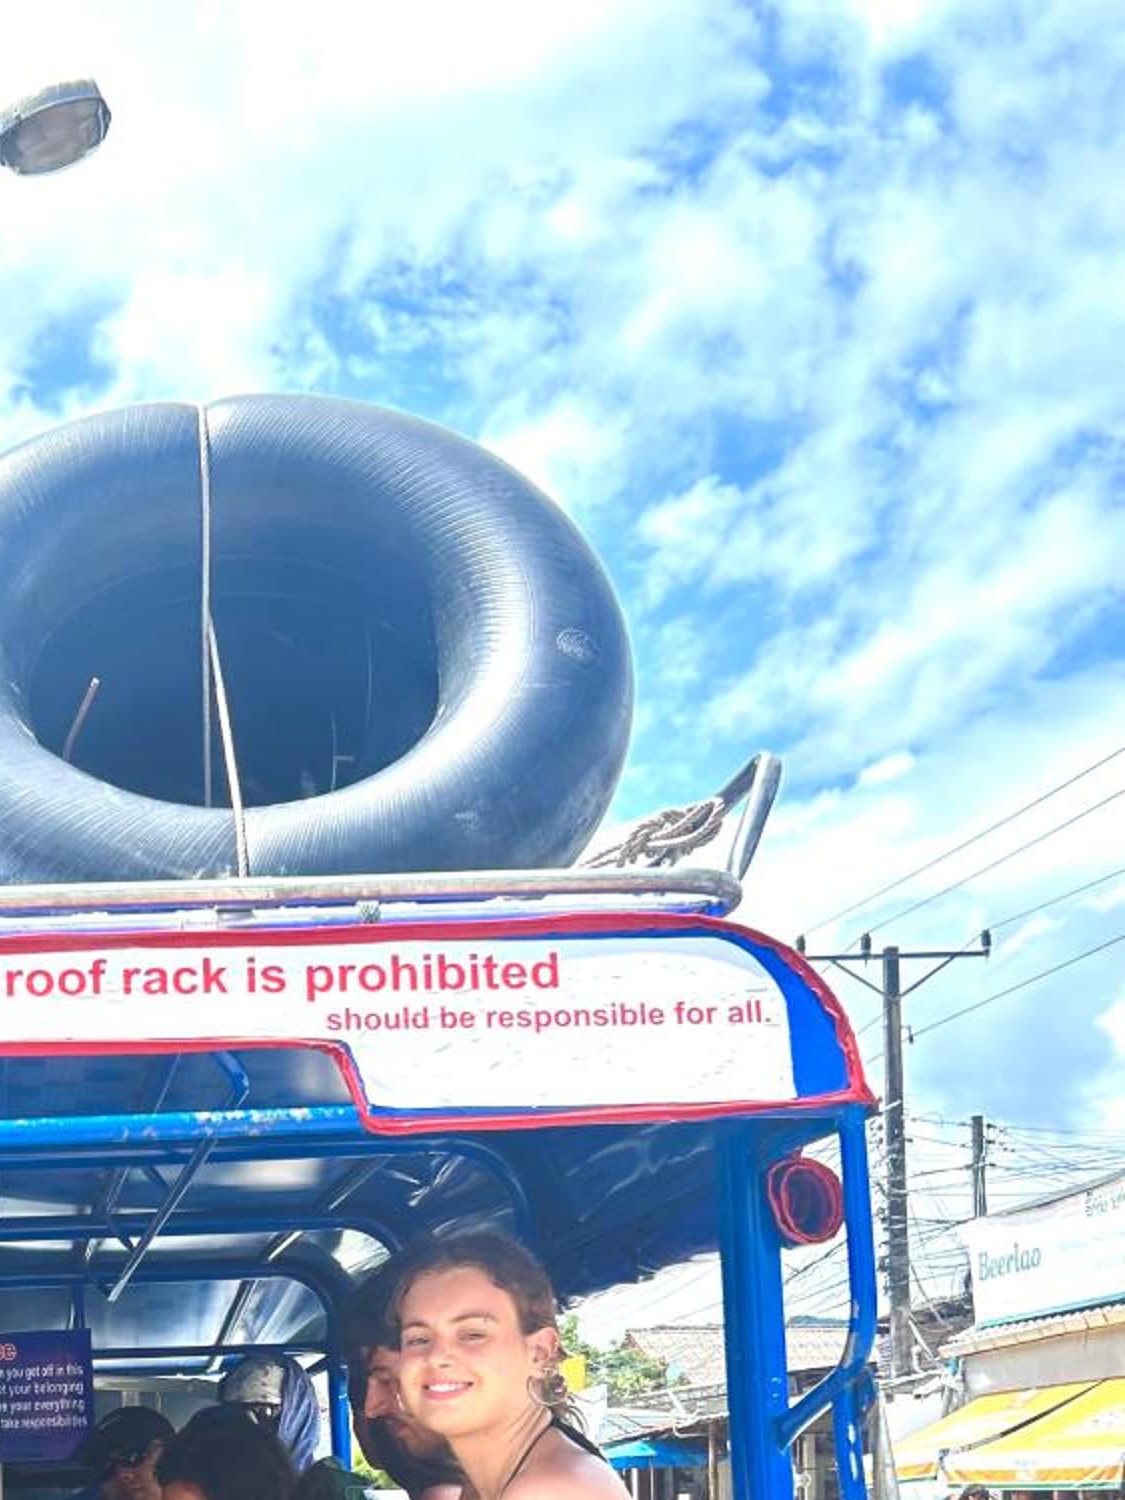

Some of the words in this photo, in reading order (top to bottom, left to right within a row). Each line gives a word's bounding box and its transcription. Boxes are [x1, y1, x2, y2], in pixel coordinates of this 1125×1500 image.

[6, 957, 107, 998] roof
[123, 957, 227, 995] rack
[247, 957, 286, 993] is
[306, 952, 559, 1002] prohibited
[327, 1007, 429, 1030] should
[440, 1007, 475, 1029] be
[487, 1003, 664, 1033] responsible
[674, 1002, 717, 1024] for
[728, 1000, 773, 1024] all.
[979, 1243, 1041, 1280] Beerlao
[6, 1368, 23, 1381] you
[9, 1384, 31, 1398] your
[35, 1398, 85, 1413] everything
